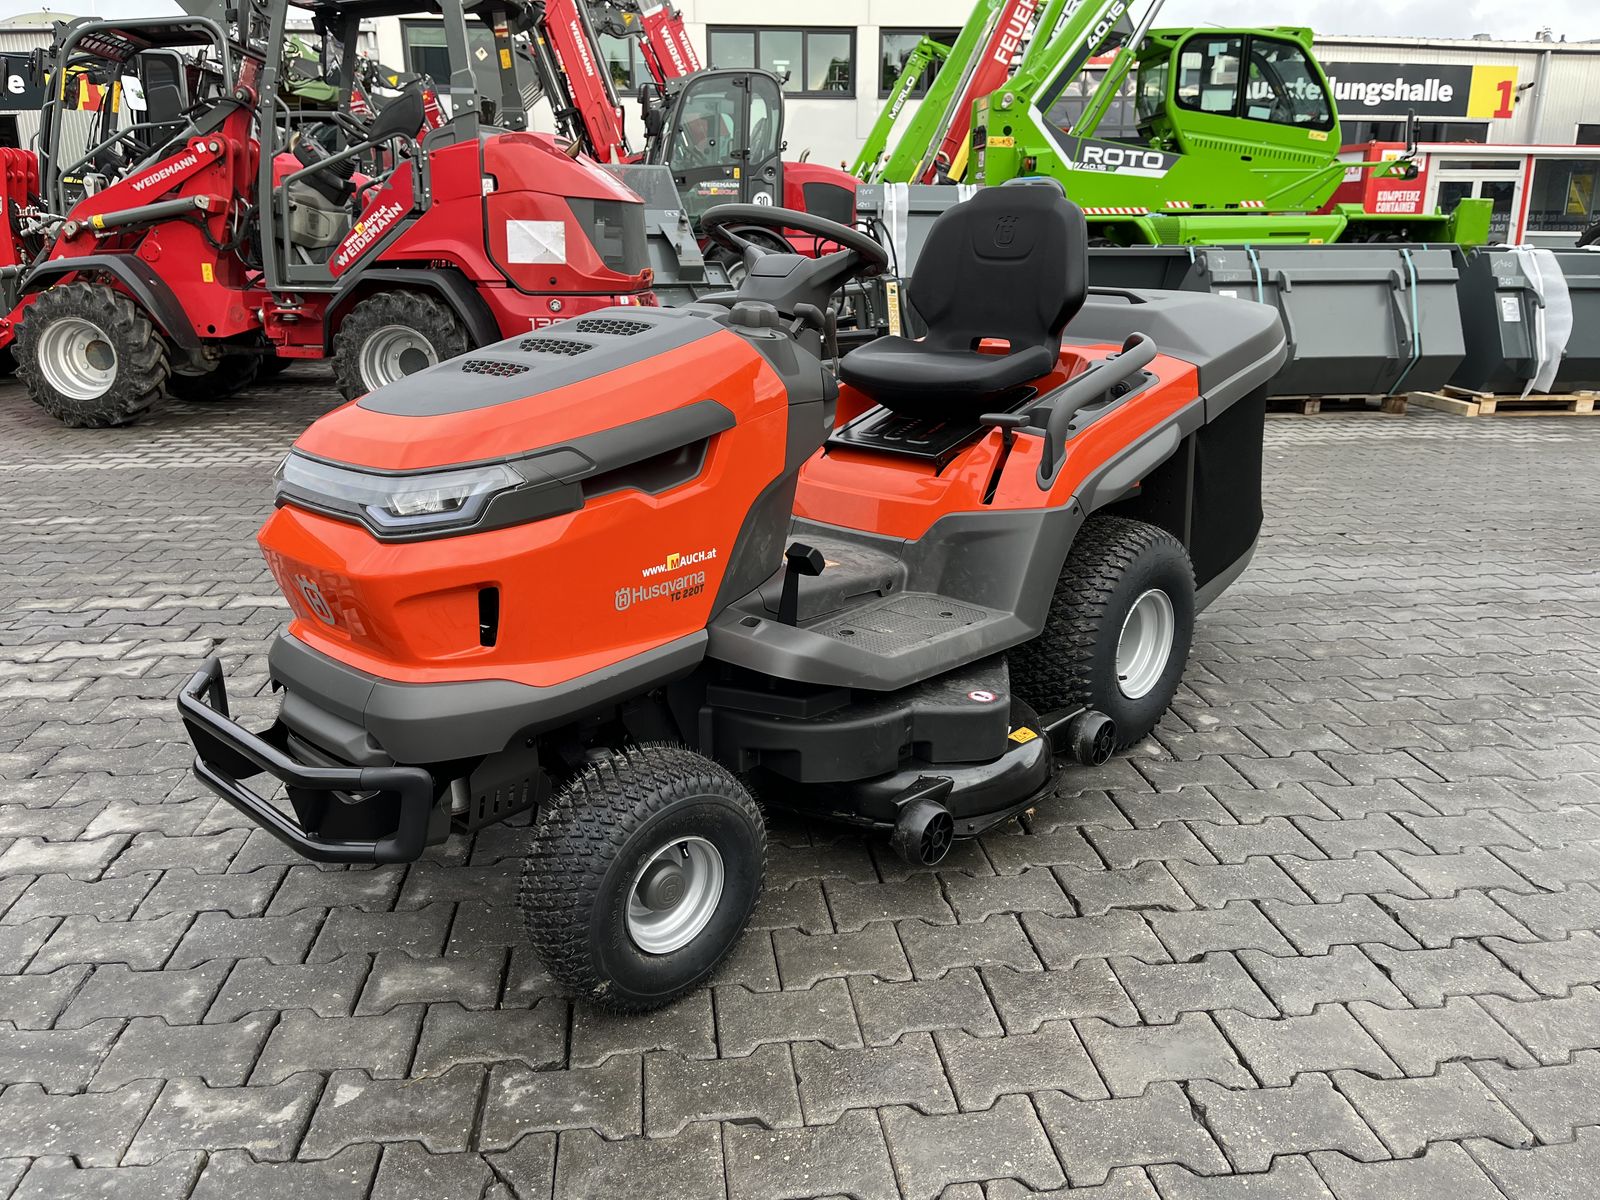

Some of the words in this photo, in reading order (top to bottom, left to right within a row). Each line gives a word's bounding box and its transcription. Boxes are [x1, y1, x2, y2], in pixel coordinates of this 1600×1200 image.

[1087, 2, 1125, 50] 40.16
[570, 20, 594, 77] WEIDEMANN
[888, 76, 915, 120] MERLO
[1232, 76, 1453, 106] usstelungshalle
[1493, 80, 1513, 119] 1
[132, 154, 198, 191] WEIDEMANN
[1083, 146, 1164, 169] ROTO
[1375, 201, 1416, 213] CONTAINER
[1377, 190, 1421, 202] KOMPETENZ
[337, 202, 403, 266] WEIDEMANN
[642, 548, 717, 577] www.MAUCH.at
[632, 570, 705, 604] Husqvarna
[670, 592, 681, 602] TC
[683, 584, 705, 599] 220T
